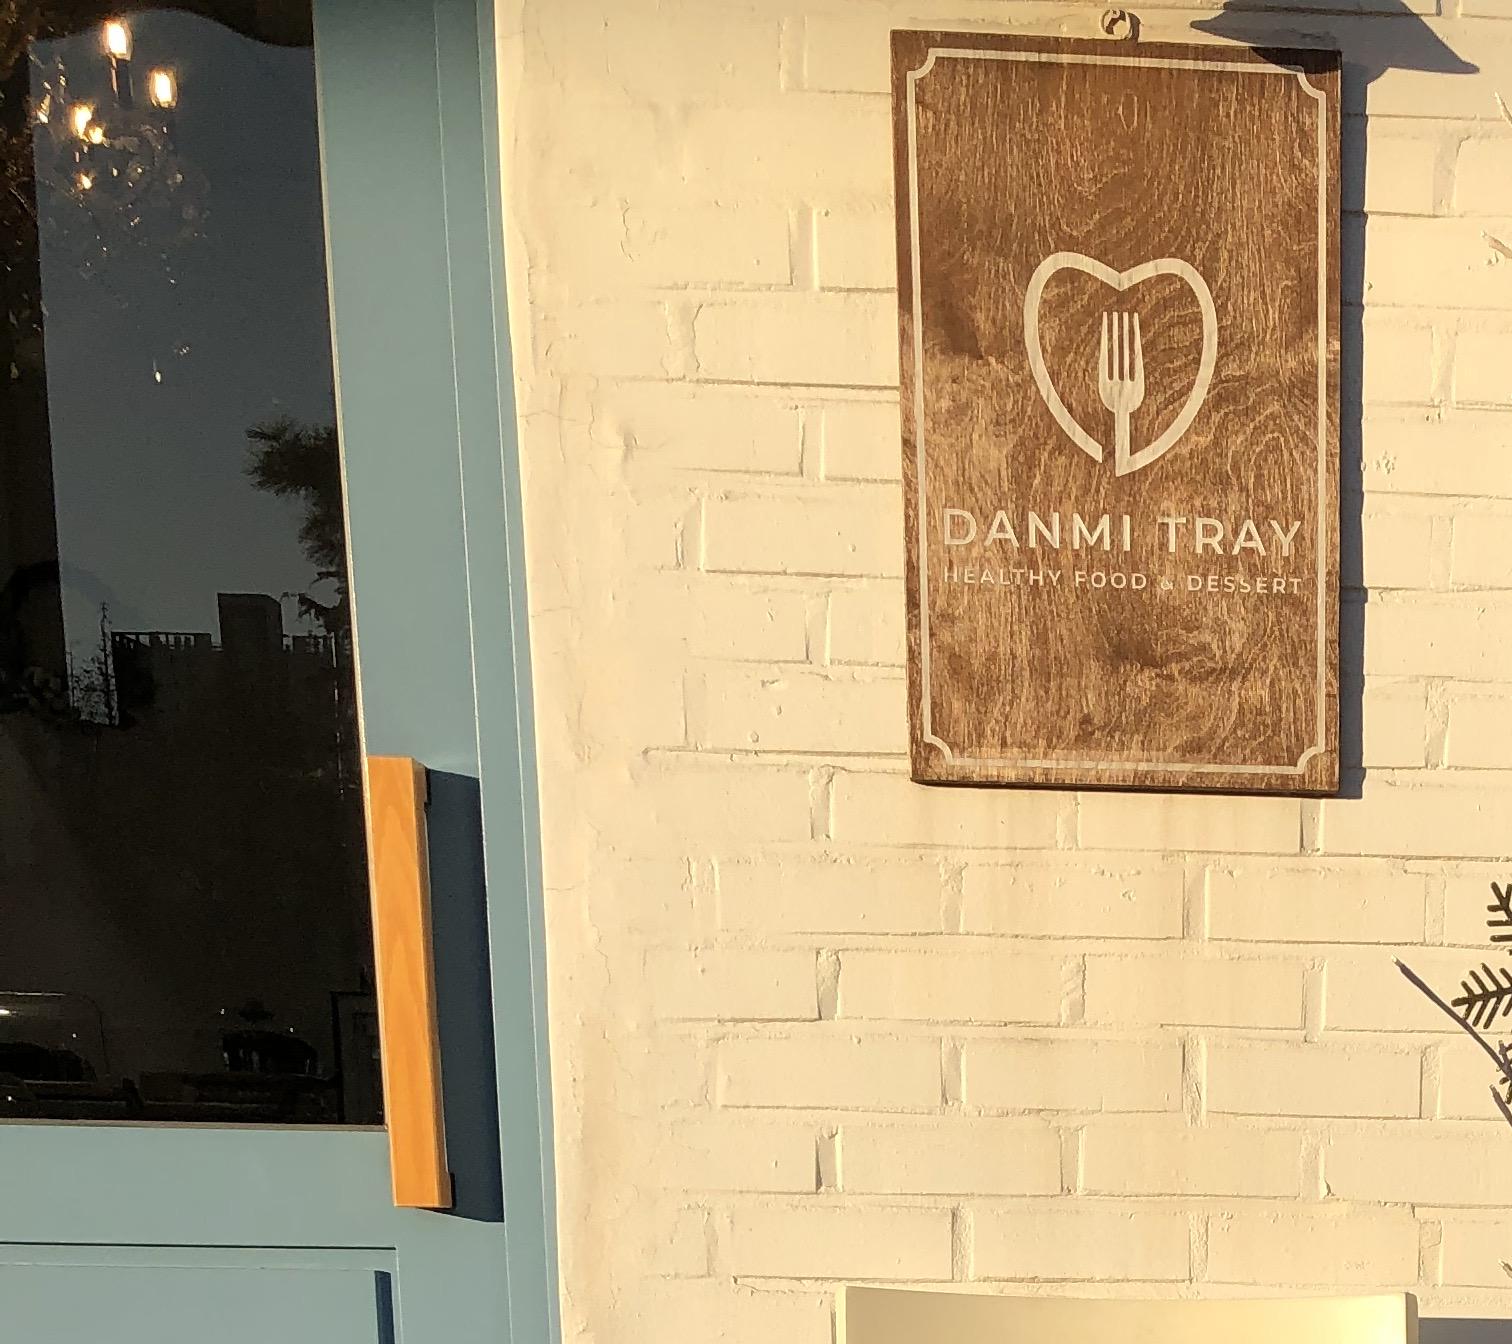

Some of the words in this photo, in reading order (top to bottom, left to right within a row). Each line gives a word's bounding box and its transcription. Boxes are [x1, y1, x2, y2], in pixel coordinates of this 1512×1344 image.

[943, 508, 1131, 552] DANMI
[1158, 516, 1301, 557] TRAY
[943, 567, 1063, 587] HEALTHY
[1075, 571, 1148, 590] FOOD
[1160, 578, 1174, 590] &
[1187, 575, 1302, 594] DESSERT
